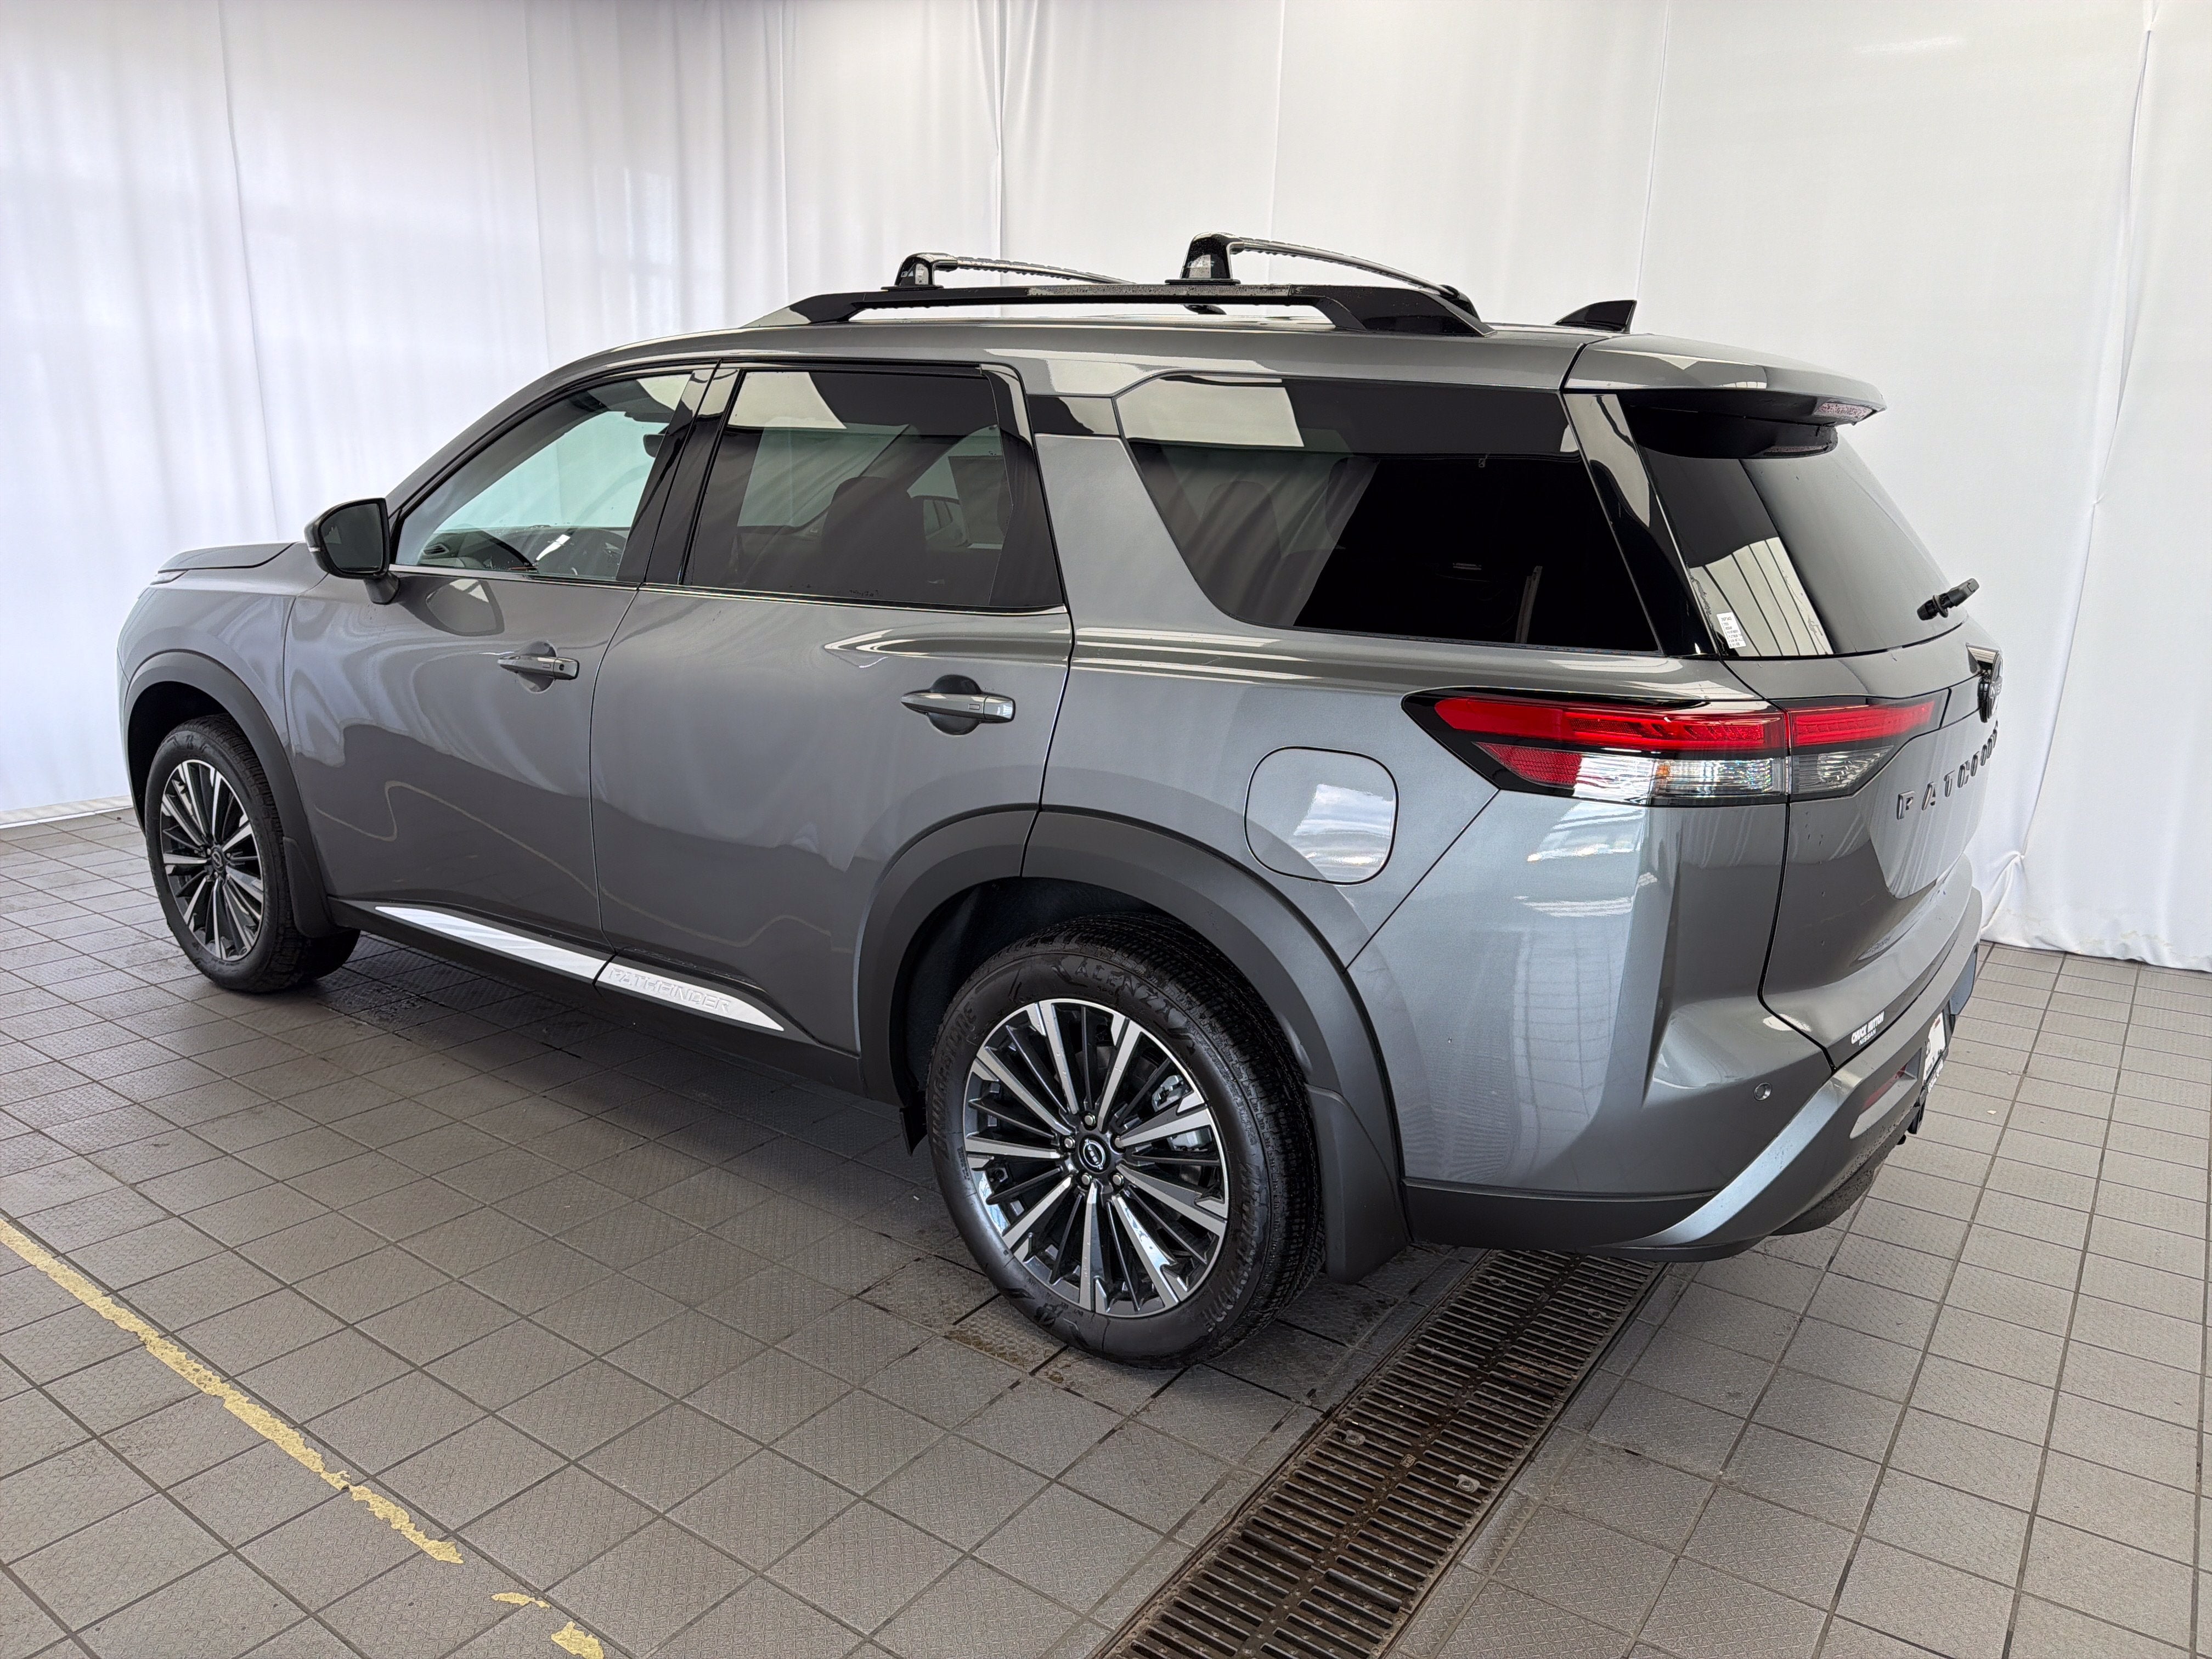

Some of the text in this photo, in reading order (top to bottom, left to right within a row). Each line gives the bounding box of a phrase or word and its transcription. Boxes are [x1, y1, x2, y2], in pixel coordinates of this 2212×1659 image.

[608, 967, 731, 1014] PATHFINDER
[1851, 1024, 1867, 1045] CHUCK
[1859, 1028, 1876, 1046] NISSAN
